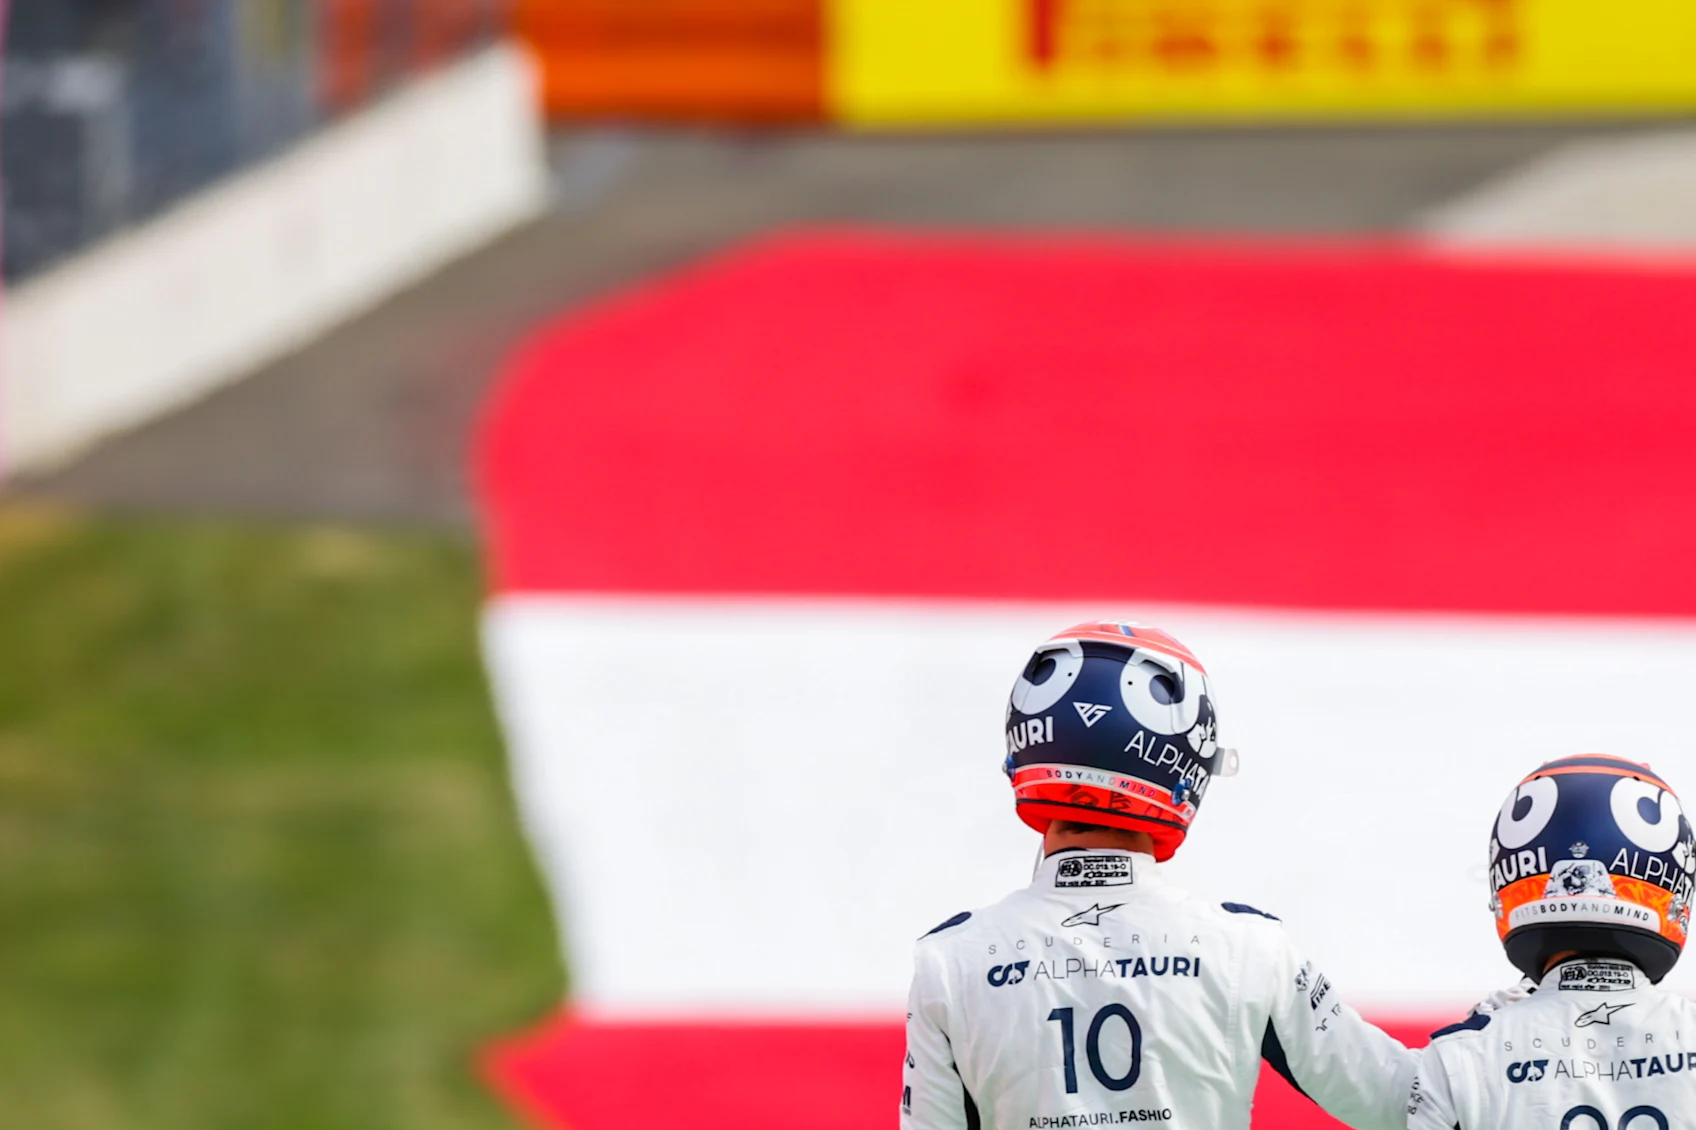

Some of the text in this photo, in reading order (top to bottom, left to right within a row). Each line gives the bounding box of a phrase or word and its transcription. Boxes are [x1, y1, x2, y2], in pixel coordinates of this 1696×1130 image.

[988, 933, 1200, 955] SCUDERIA
[1034, 956, 1200, 980] ALPHATAURI
[1047, 1003, 1142, 1094] 10
